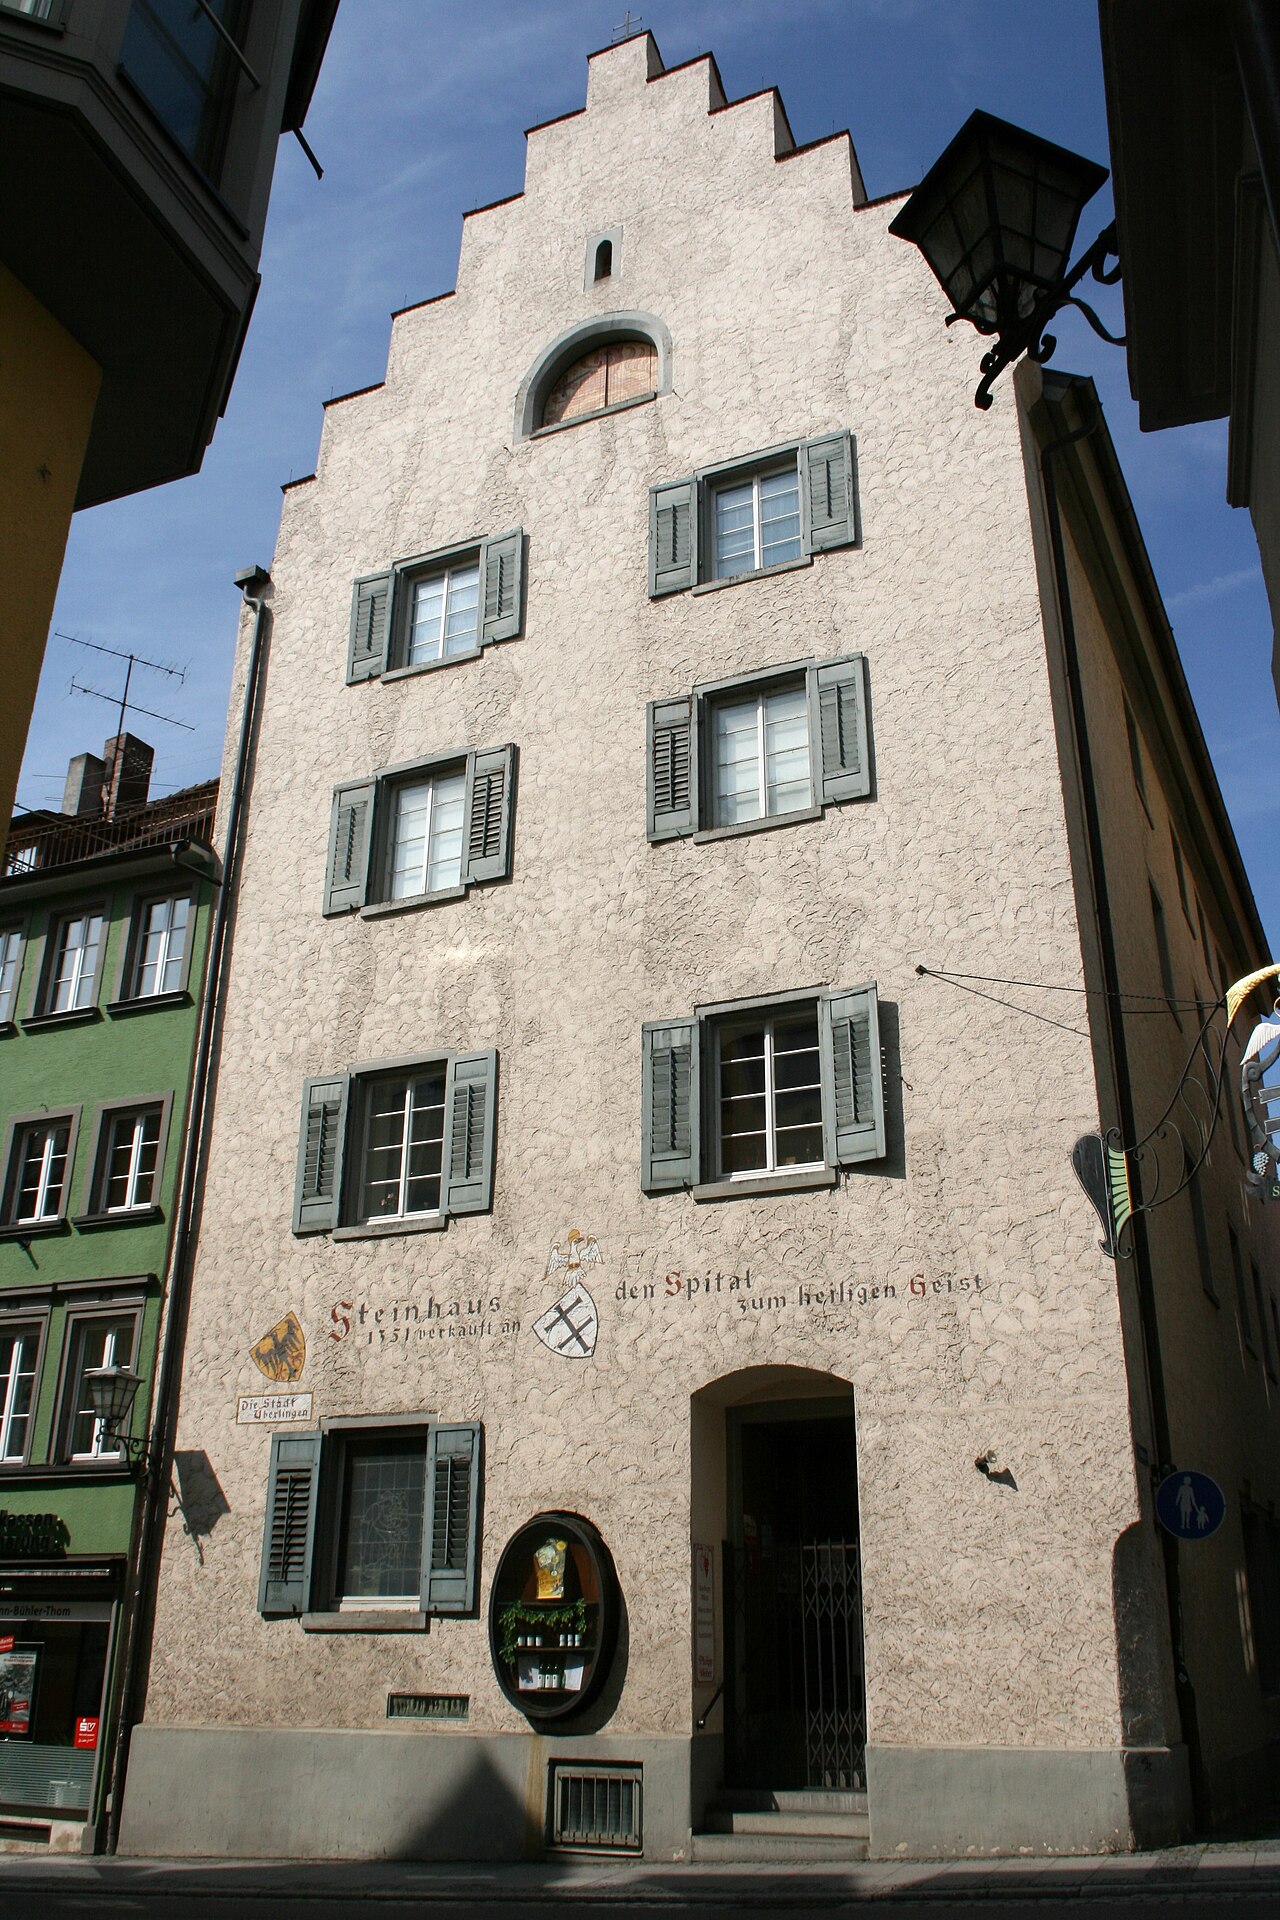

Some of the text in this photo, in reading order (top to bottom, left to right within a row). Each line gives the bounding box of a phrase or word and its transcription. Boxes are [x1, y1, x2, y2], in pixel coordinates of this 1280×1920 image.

[615, 1269, 752, 1300] den Spital
[737, 1272, 982, 1314] zum heiligen Geist
[329, 1296, 501, 1342] Steinhaus
[418, 1319, 493, 1341] verkauft
[242, 1397, 297, 1410] Die Stadt
